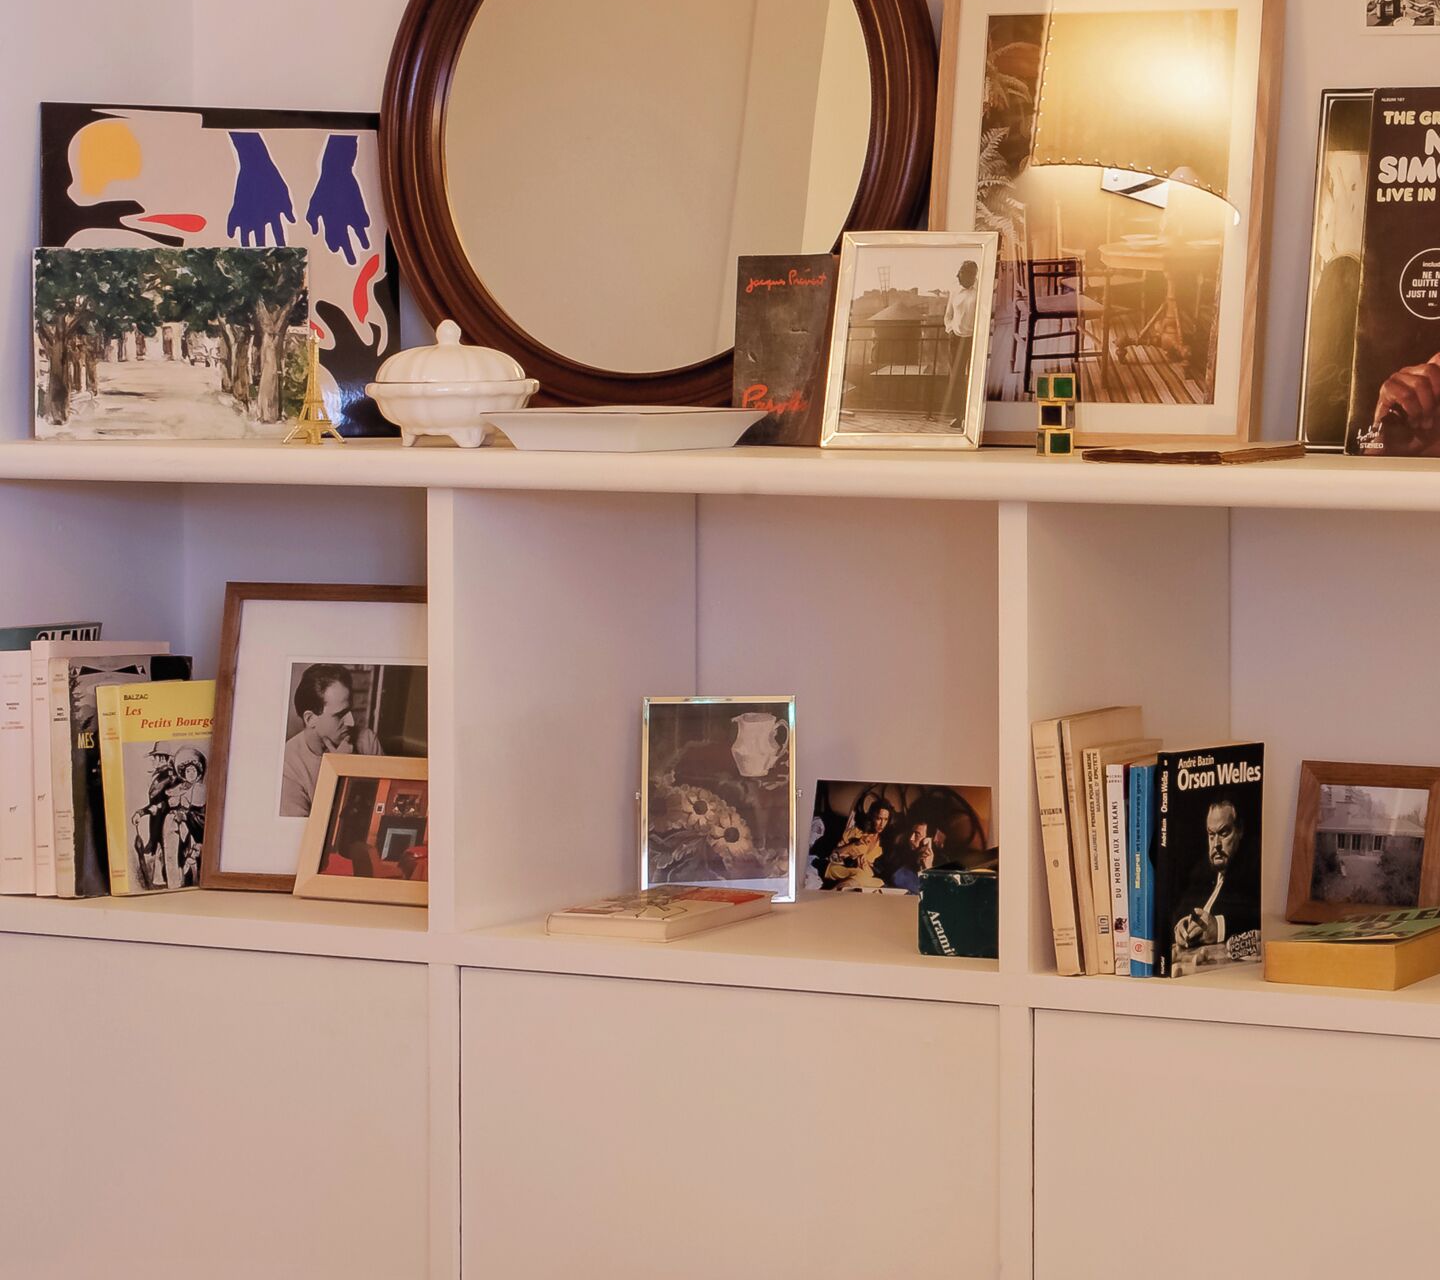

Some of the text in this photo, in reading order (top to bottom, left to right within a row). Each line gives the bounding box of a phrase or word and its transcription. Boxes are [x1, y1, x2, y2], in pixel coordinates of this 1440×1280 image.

[1383, 110, 1416, 125] THE
[1376, 188, 1414, 203] LIVE
[1418, 188, 1436, 202] IN
[745, 268, 828, 293] Jacques Prévert
[1422, 271, 1433, 279] NE
[1412, 279, 1439, 287] QUITTE
[1406, 290, 1426, 298] JUST
[1428, 290, 1437, 298] IN
[125, 706, 142, 716] Les
[140, 717, 172, 729] Petits
[77, 732, 94, 749] MES
[1178, 754, 1214, 769] André Bazin
[1178, 761, 1261, 790] Orson Welles
[1111, 801, 1119, 834] BALKANS
[1116, 888, 1121, 898] DU
